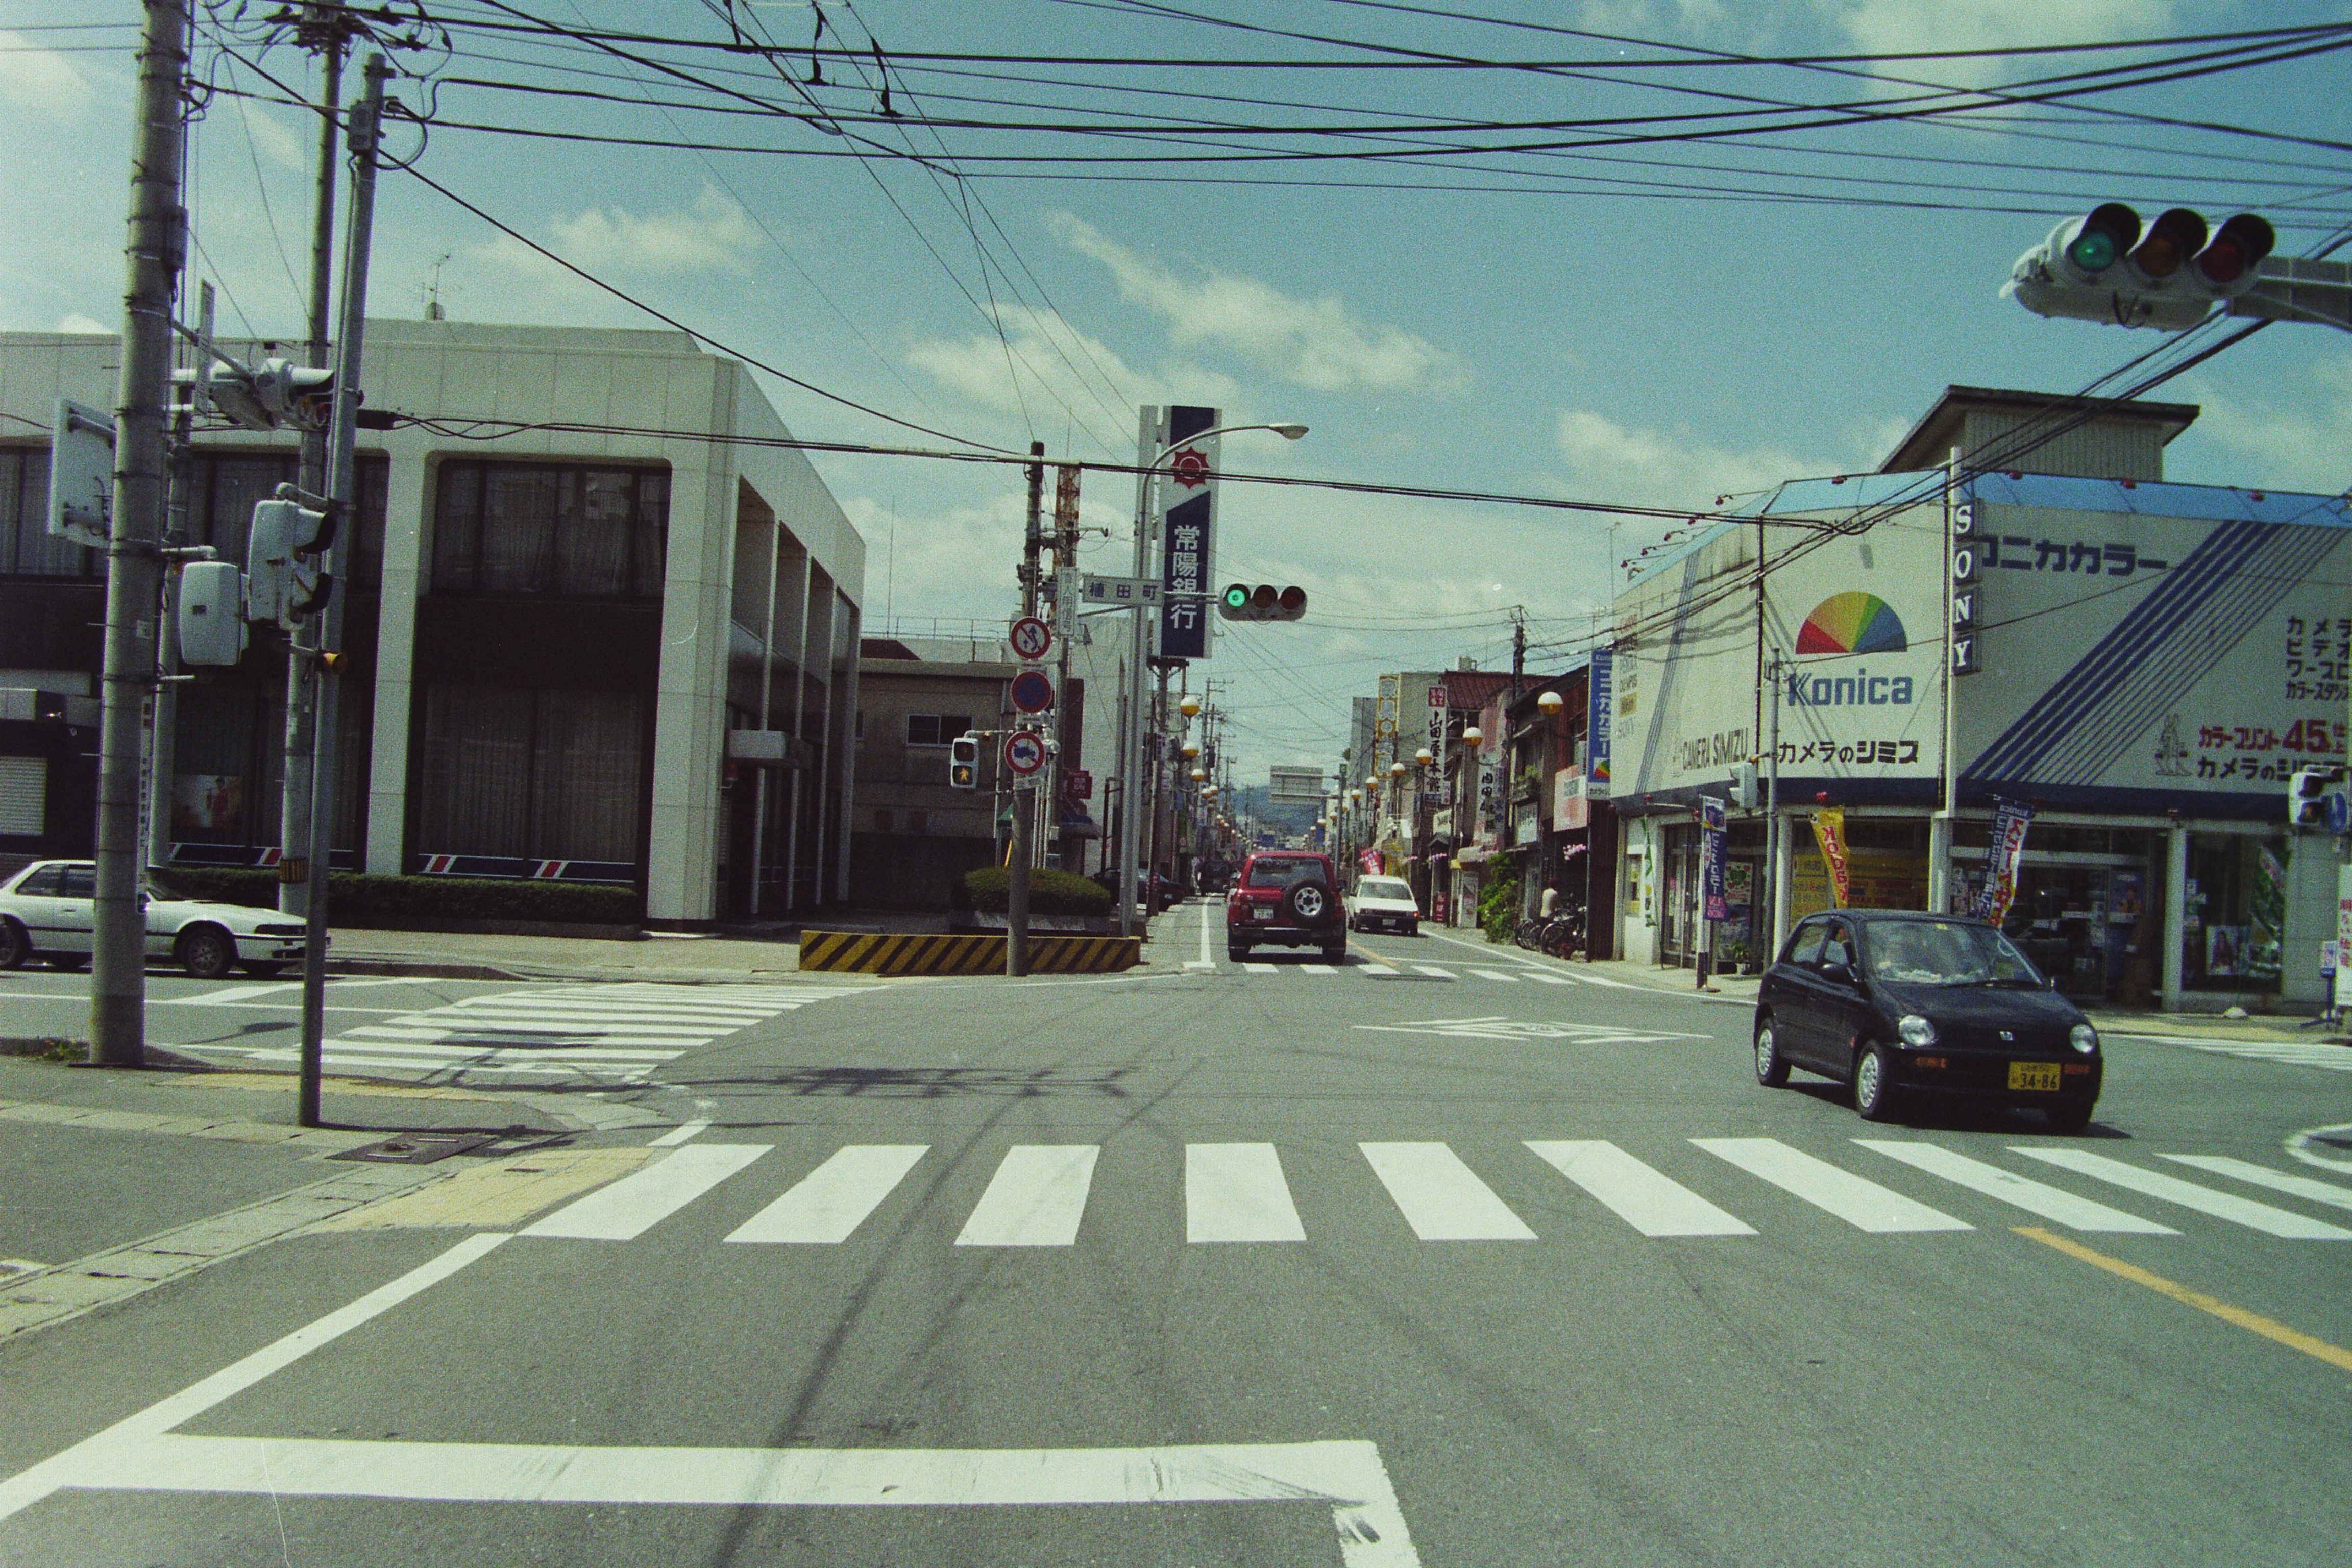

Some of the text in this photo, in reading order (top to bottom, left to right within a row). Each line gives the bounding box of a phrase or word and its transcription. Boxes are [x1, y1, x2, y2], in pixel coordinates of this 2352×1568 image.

[1169, 525, 1199, 630] 常陽銀行
[1954, 504, 1972, 667] SONY
[1787, 668, 1913, 707] Konica
